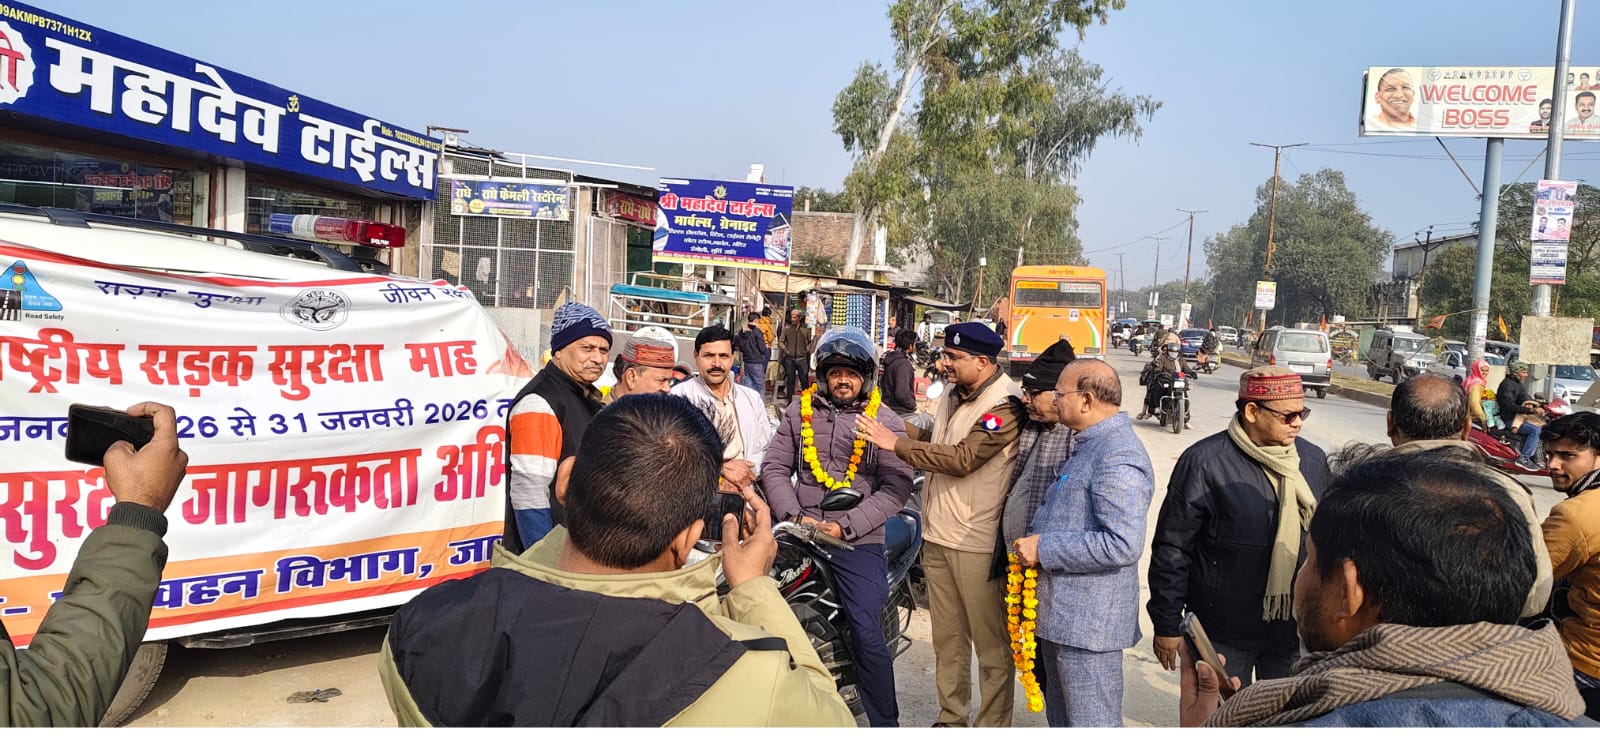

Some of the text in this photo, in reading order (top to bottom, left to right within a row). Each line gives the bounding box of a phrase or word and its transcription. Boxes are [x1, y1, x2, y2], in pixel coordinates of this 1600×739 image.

[1422, 83, 1538, 103] WELCOME
[45, 37, 286, 153] महादेव
[299, 113, 438, 190] टाईल्स
[1444, 108, 1510, 127] BOSS
[456, 186, 472, 199] राधे
[481, 186, 498, 200] राधे
[659, 193, 776, 218] श्री महादेव टाईल्स
[379, 284, 434, 304] जीवन
[44, 313, 65, 321] Safety
[138, 345, 258, 398] सड़क
[268, 343, 384, 401] सुरक्षा
[405, 340, 477, 378] माह
[227, 407, 257, 437] से
[268, 412, 308, 435] 31
[317, 398, 414, 431] जनवरी
[424, 399, 489, 425] 2026
[276, 548, 433, 593] विभाग,
